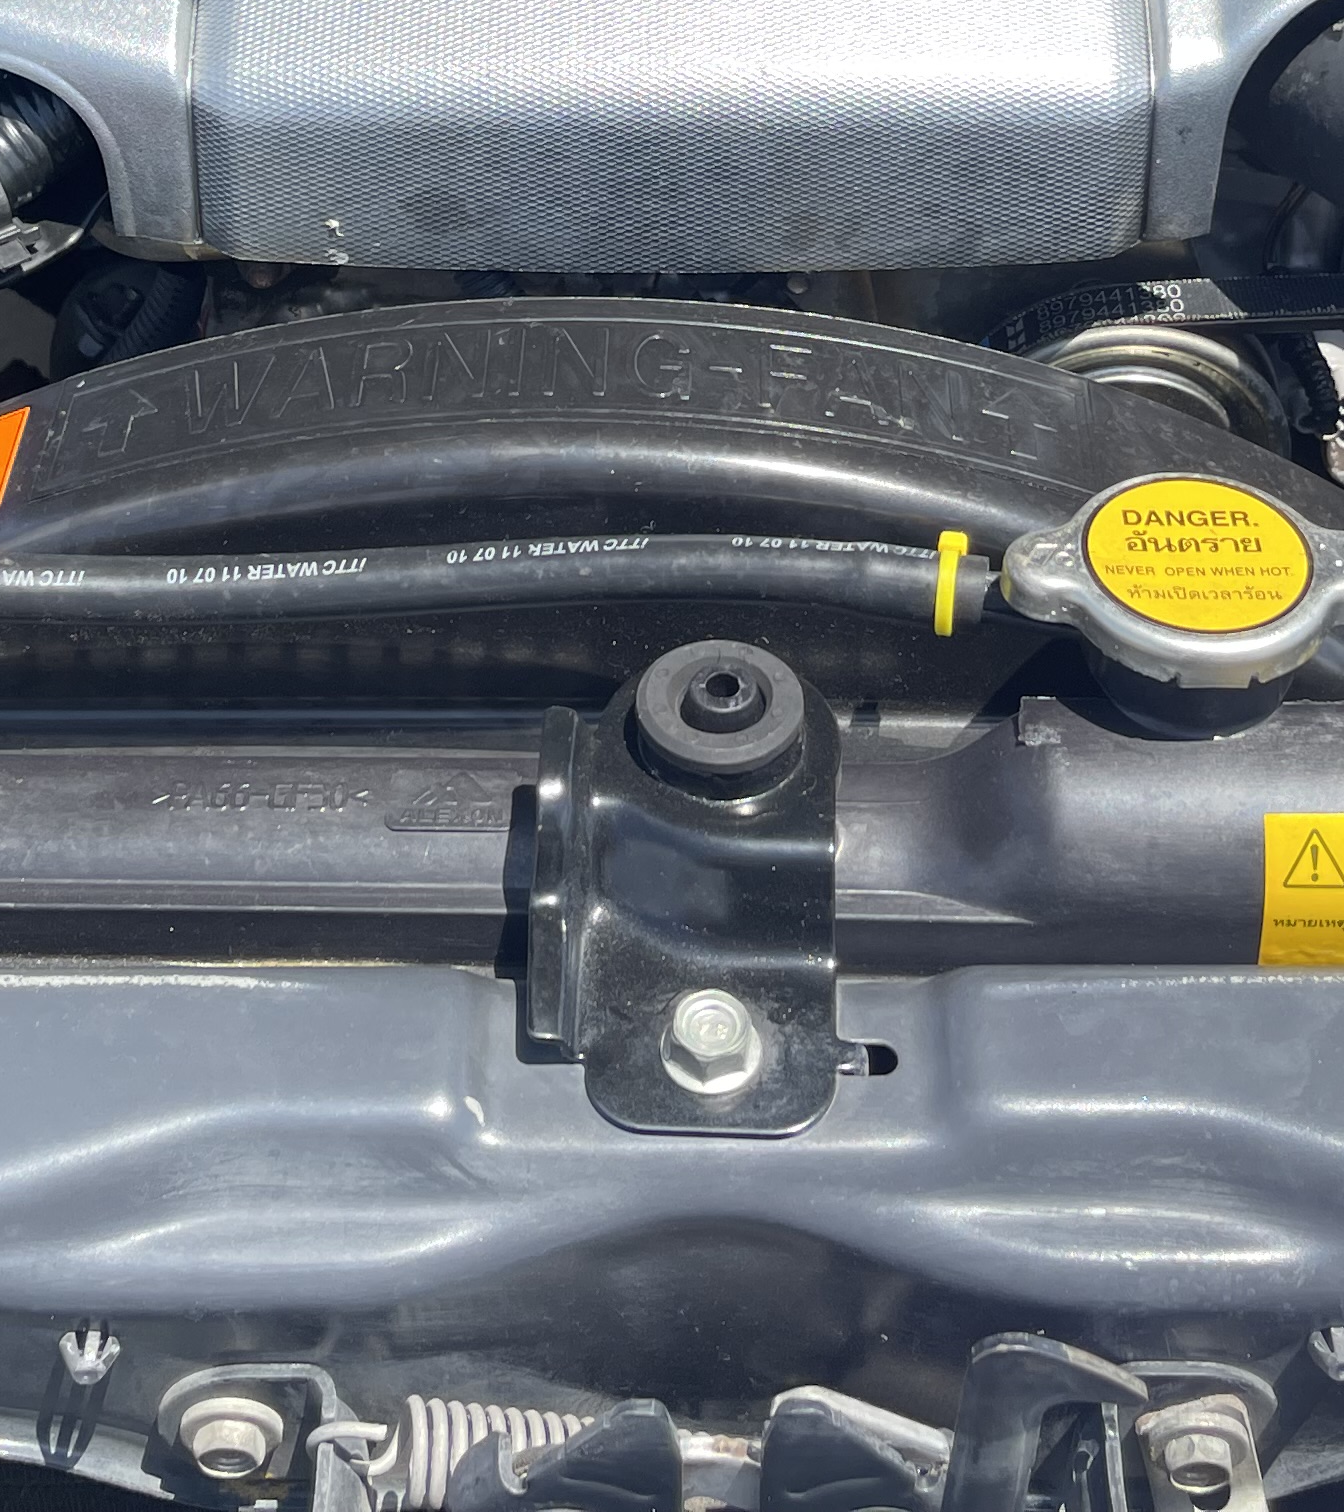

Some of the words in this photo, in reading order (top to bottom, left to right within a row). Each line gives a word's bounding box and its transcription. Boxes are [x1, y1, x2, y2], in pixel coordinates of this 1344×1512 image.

[1121, 509, 1260, 528] DANGER.
[527, 538, 599, 558] WATER
[731, 536, 754, 548] 10
[759, 538, 783, 549] 07
[788, 539, 810, 550] 11
[815, 540, 889, 554] WATER
[1125, 530, 1263, 554] อันตราย
[446, 548, 468, 565] 10
[472, 546, 496, 563] 07
[501, 545, 523, 561] 11
[166, 567, 188, 585] 10
[192, 567, 215, 584] 07
[221, 565, 242, 583] 11
[247, 560, 319, 581] WATER
[1105, 564, 1156, 577] NEVER
[1164, 565, 1206, 578] OPEN
[1210, 566, 1256, 578] WHEN
[1126, 584, 1283, 601] ห้ามเปิดเวลาร้อน
